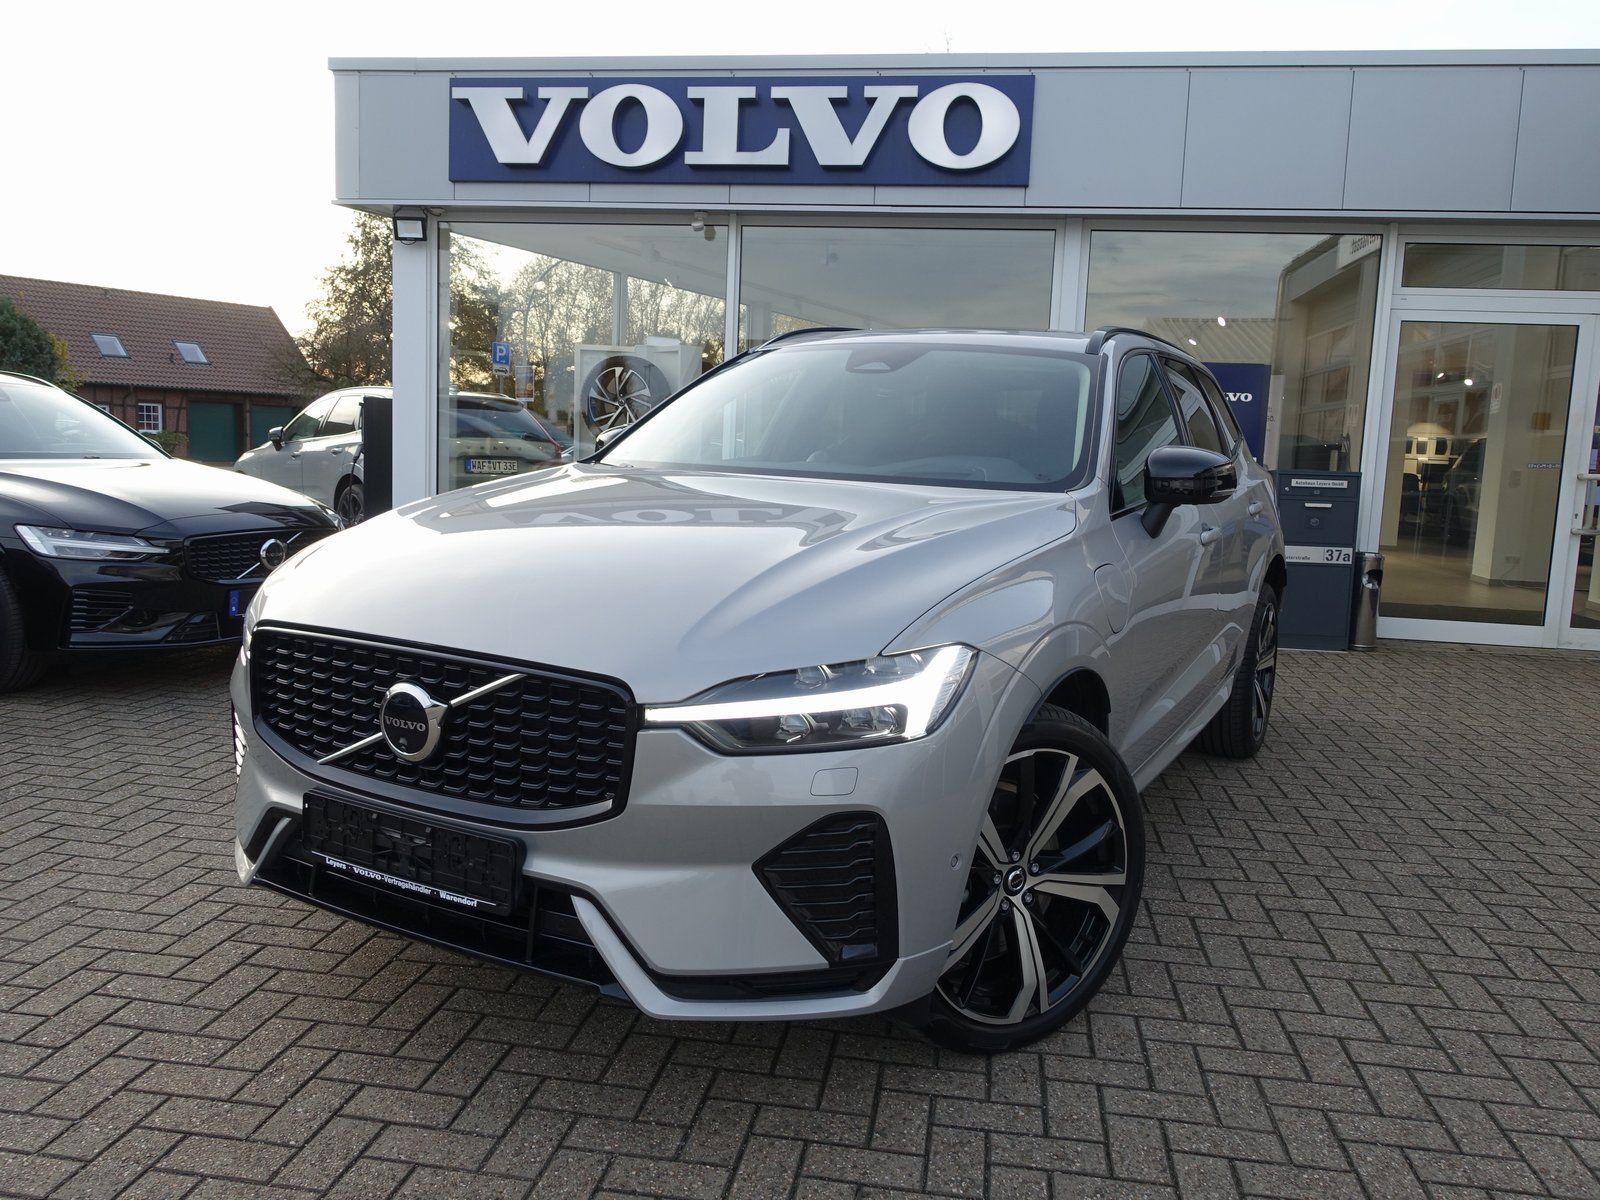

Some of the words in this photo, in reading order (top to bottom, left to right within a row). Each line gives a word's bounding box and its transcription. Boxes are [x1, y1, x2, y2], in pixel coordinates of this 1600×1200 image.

[451, 82, 1021, 169] VOLVO
[496, 346, 506, 361] P
[1325, 549, 1350, 562] 37a
[384, 715, 426, 732] VOLVO
[325, 856, 347, 870] Leyers
[439, 890, 478, 908] Warendorf
